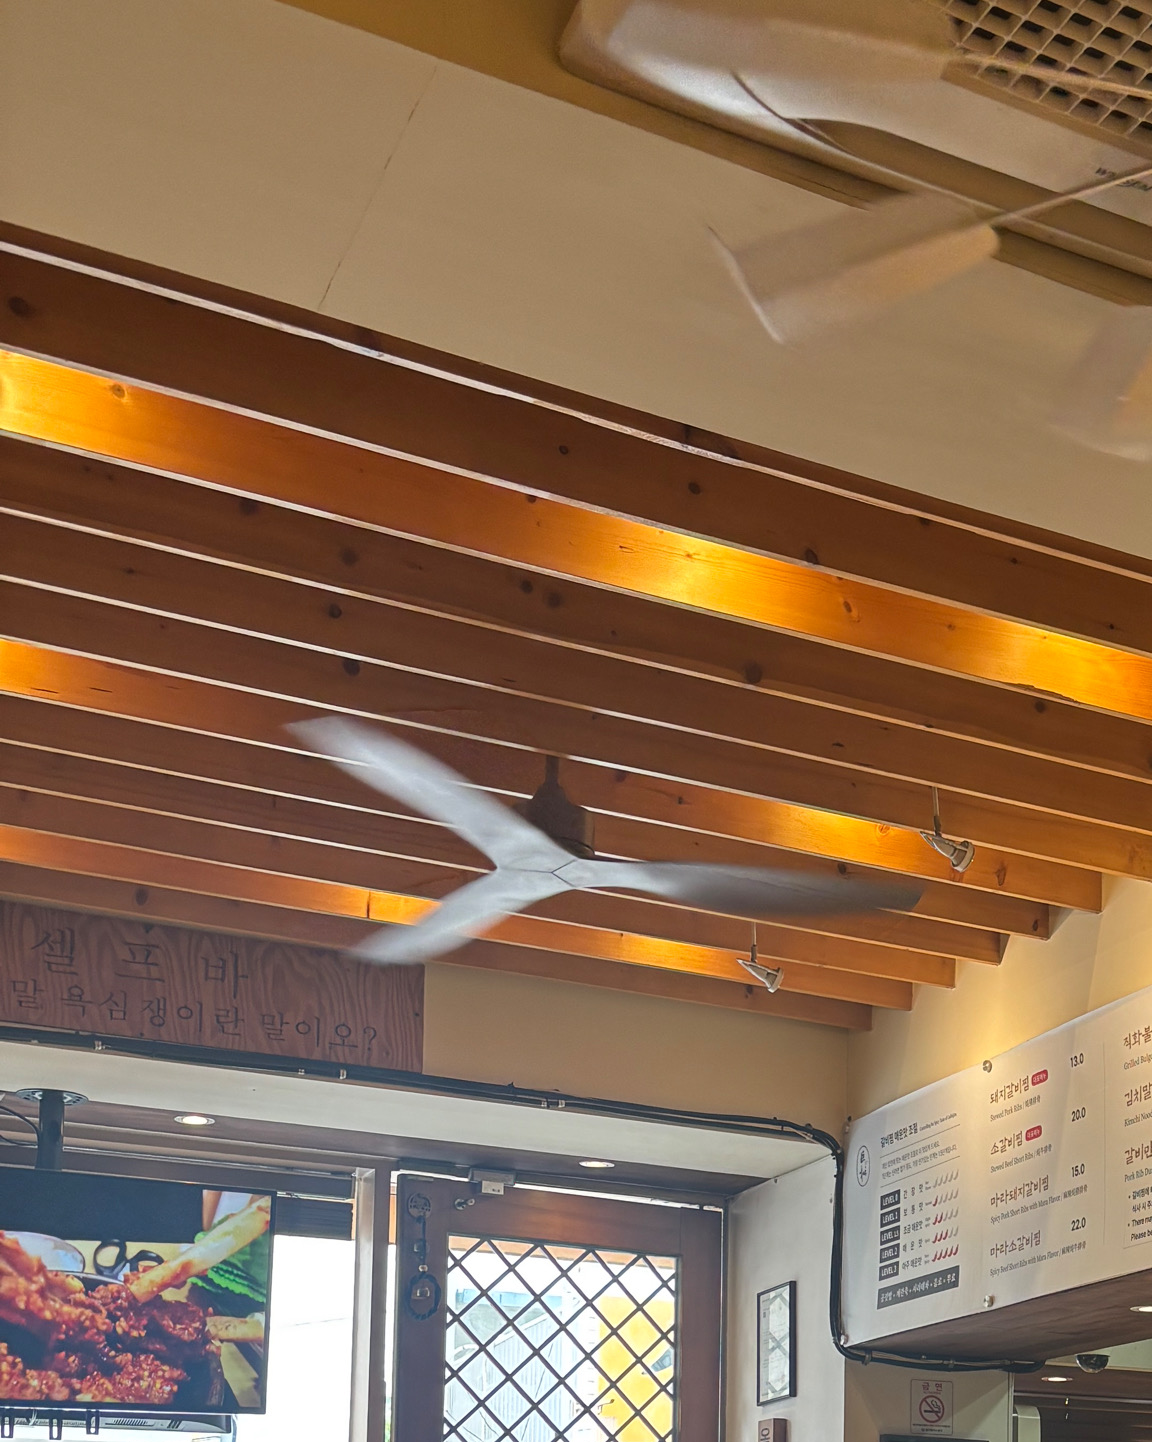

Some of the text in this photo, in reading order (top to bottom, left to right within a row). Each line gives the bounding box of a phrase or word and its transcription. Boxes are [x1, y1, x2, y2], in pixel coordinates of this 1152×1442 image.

[30, 927, 249, 1000] 셀프바
[60, 984, 246, 1036] 욕심쟁이란
[260, 1011, 378, 1051] 말이오?
[1070, 1053, 1084, 1068] 13.0
[990, 1075, 1029, 1104] 돼지갈비찜
[1071, 1106, 1087, 1122] 20.0
[990, 1130, 1023, 1155] 소갈비찜
[1071, 1163, 1085, 1178] 15.0
[1124, 1172, 1135, 1183] Pork
[1135, 1169, 1144, 1179] Rib
[990, 1174, 1049, 1208] 마라돼지갈비찜
[882, 1194, 895, 1206] LEVEL
[882, 1212, 895, 1224] LEVEL
[1071, 1217, 1087, 1231] 22.0
[1131, 1217, 1145, 1228] There
[881, 1231, 893, 1242] LEVEL
[1130, 1230, 1146, 1241] Please
[990, 1230, 1041, 1258] 마라소갈비찜
[882, 1247, 898, 1259] LEVEL 2
[881, 1264, 897, 1277] LEVEL 3
